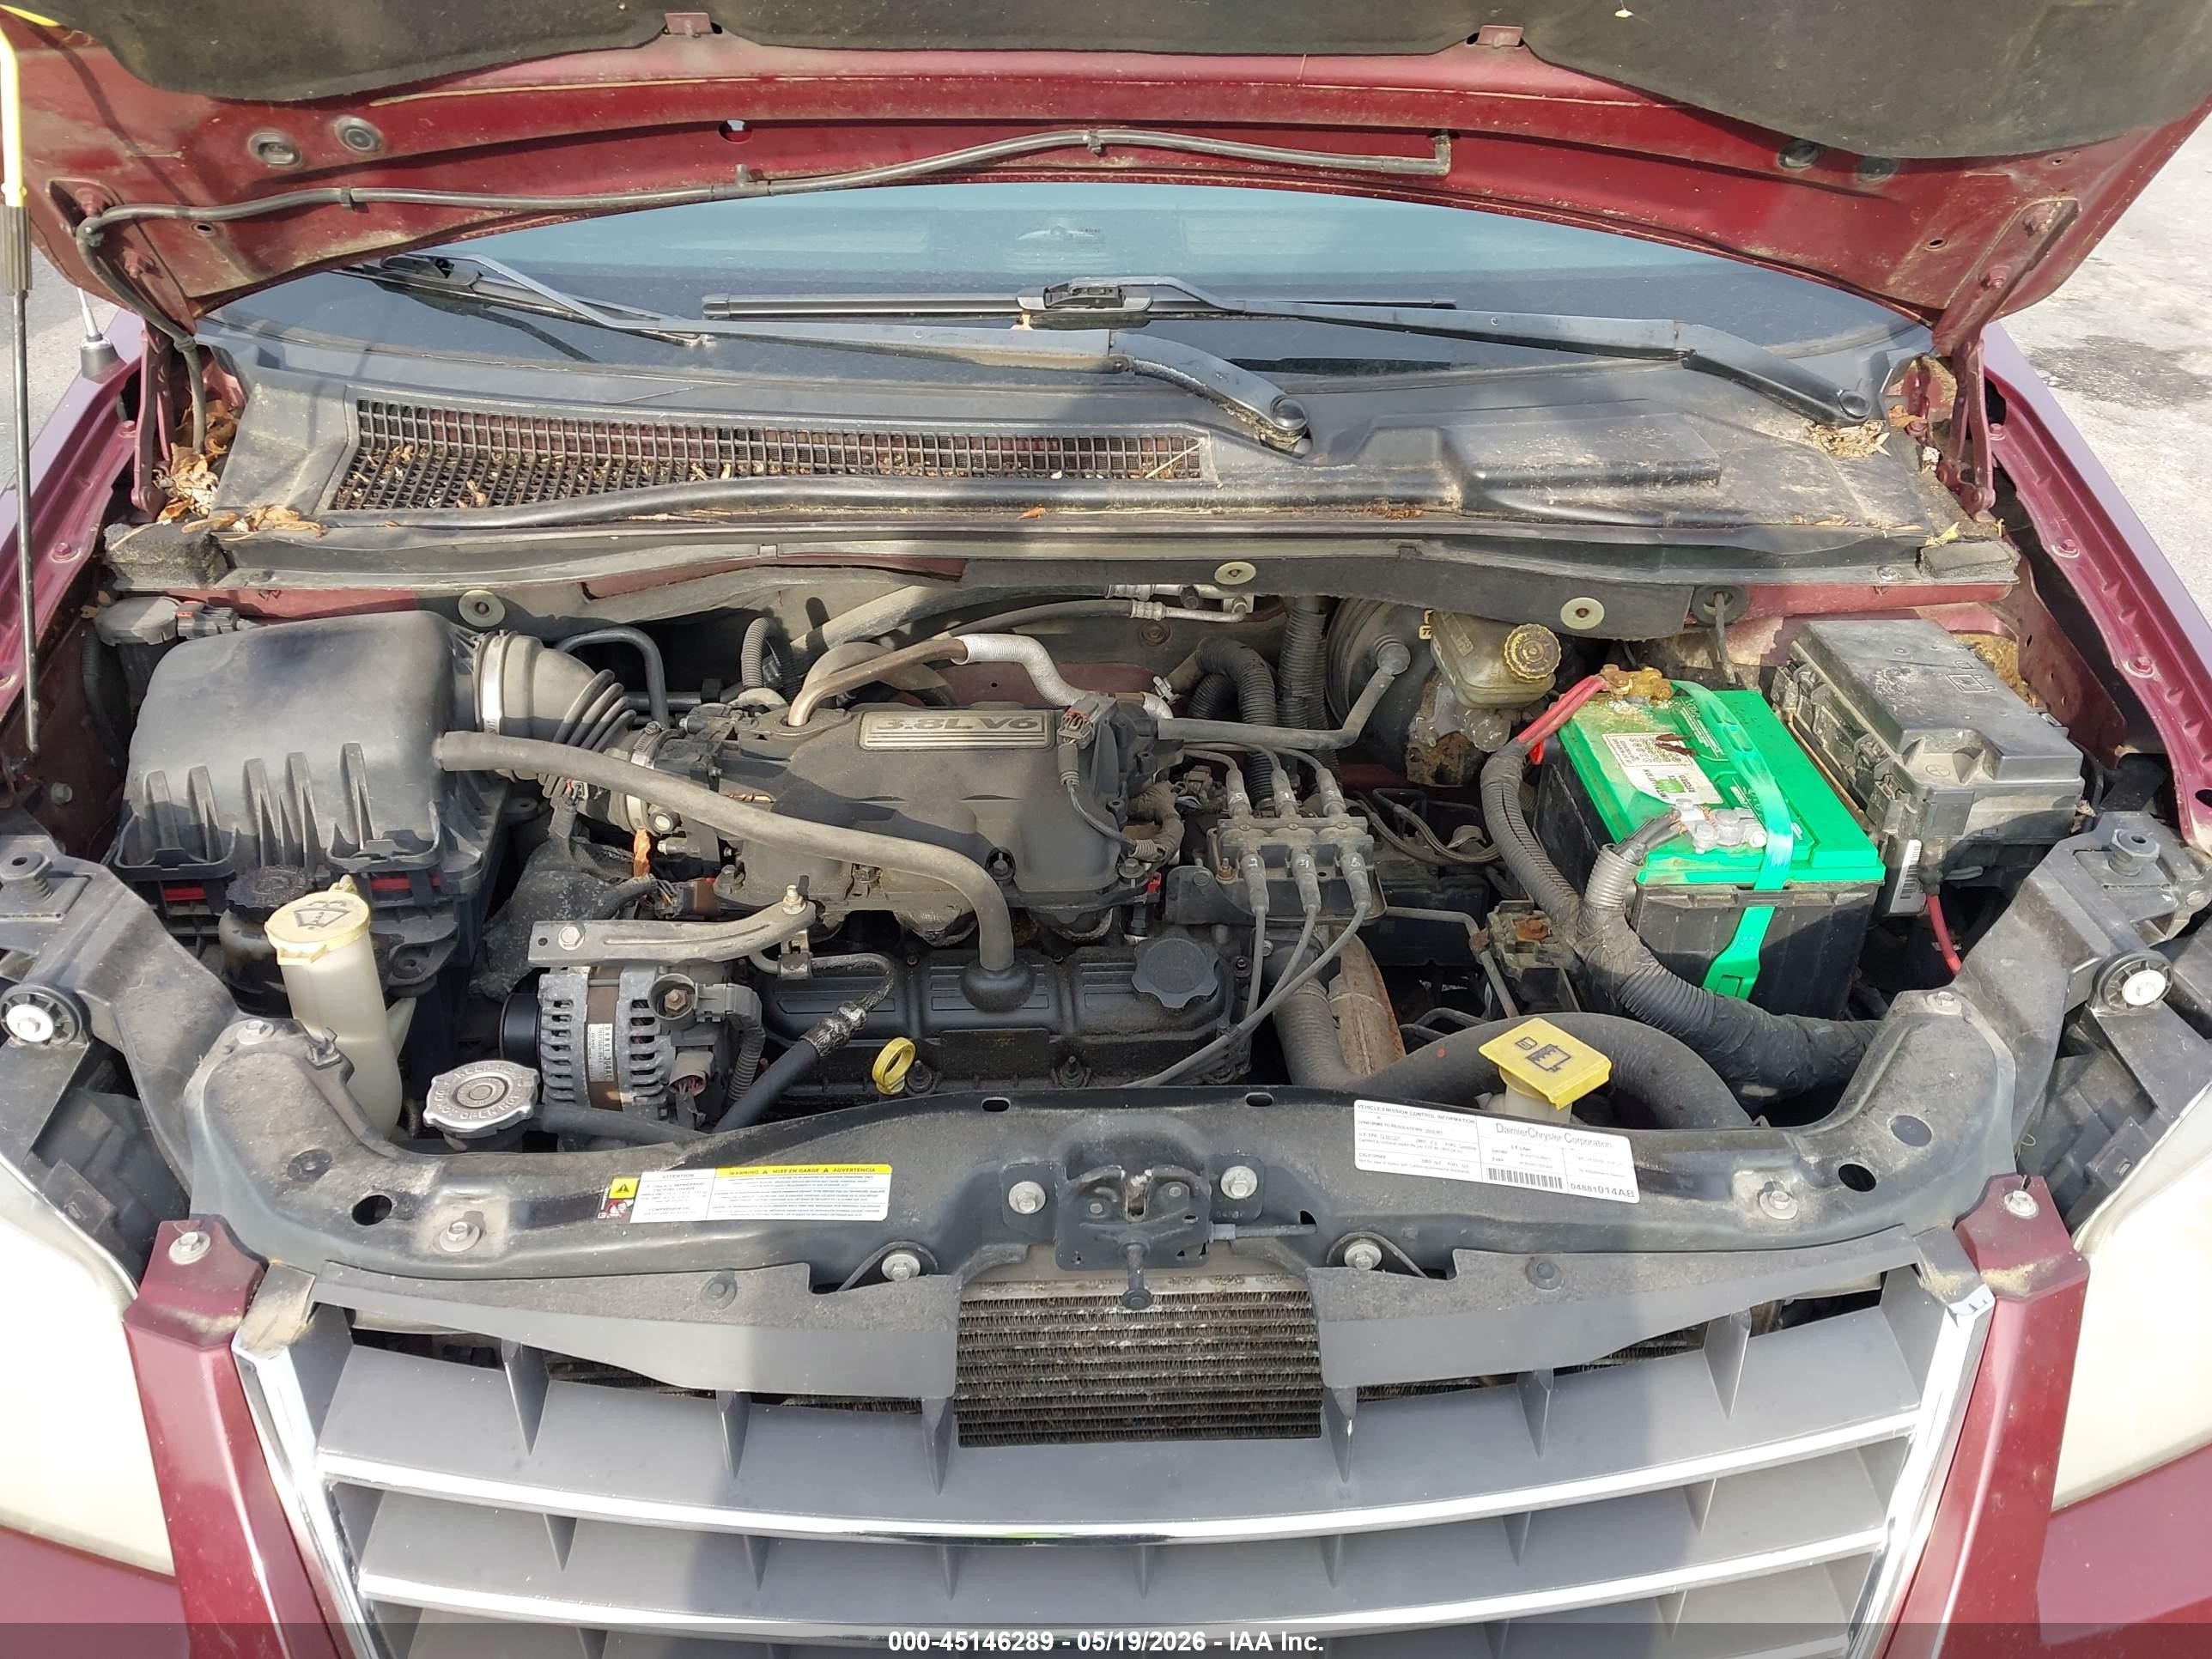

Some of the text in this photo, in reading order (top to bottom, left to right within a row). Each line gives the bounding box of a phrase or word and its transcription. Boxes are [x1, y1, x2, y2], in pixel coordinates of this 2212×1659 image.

[877, 716, 1039, 730] 3.8L V6
[1496, 1122, 1613, 1149] DaimlerChrysler Corporation
